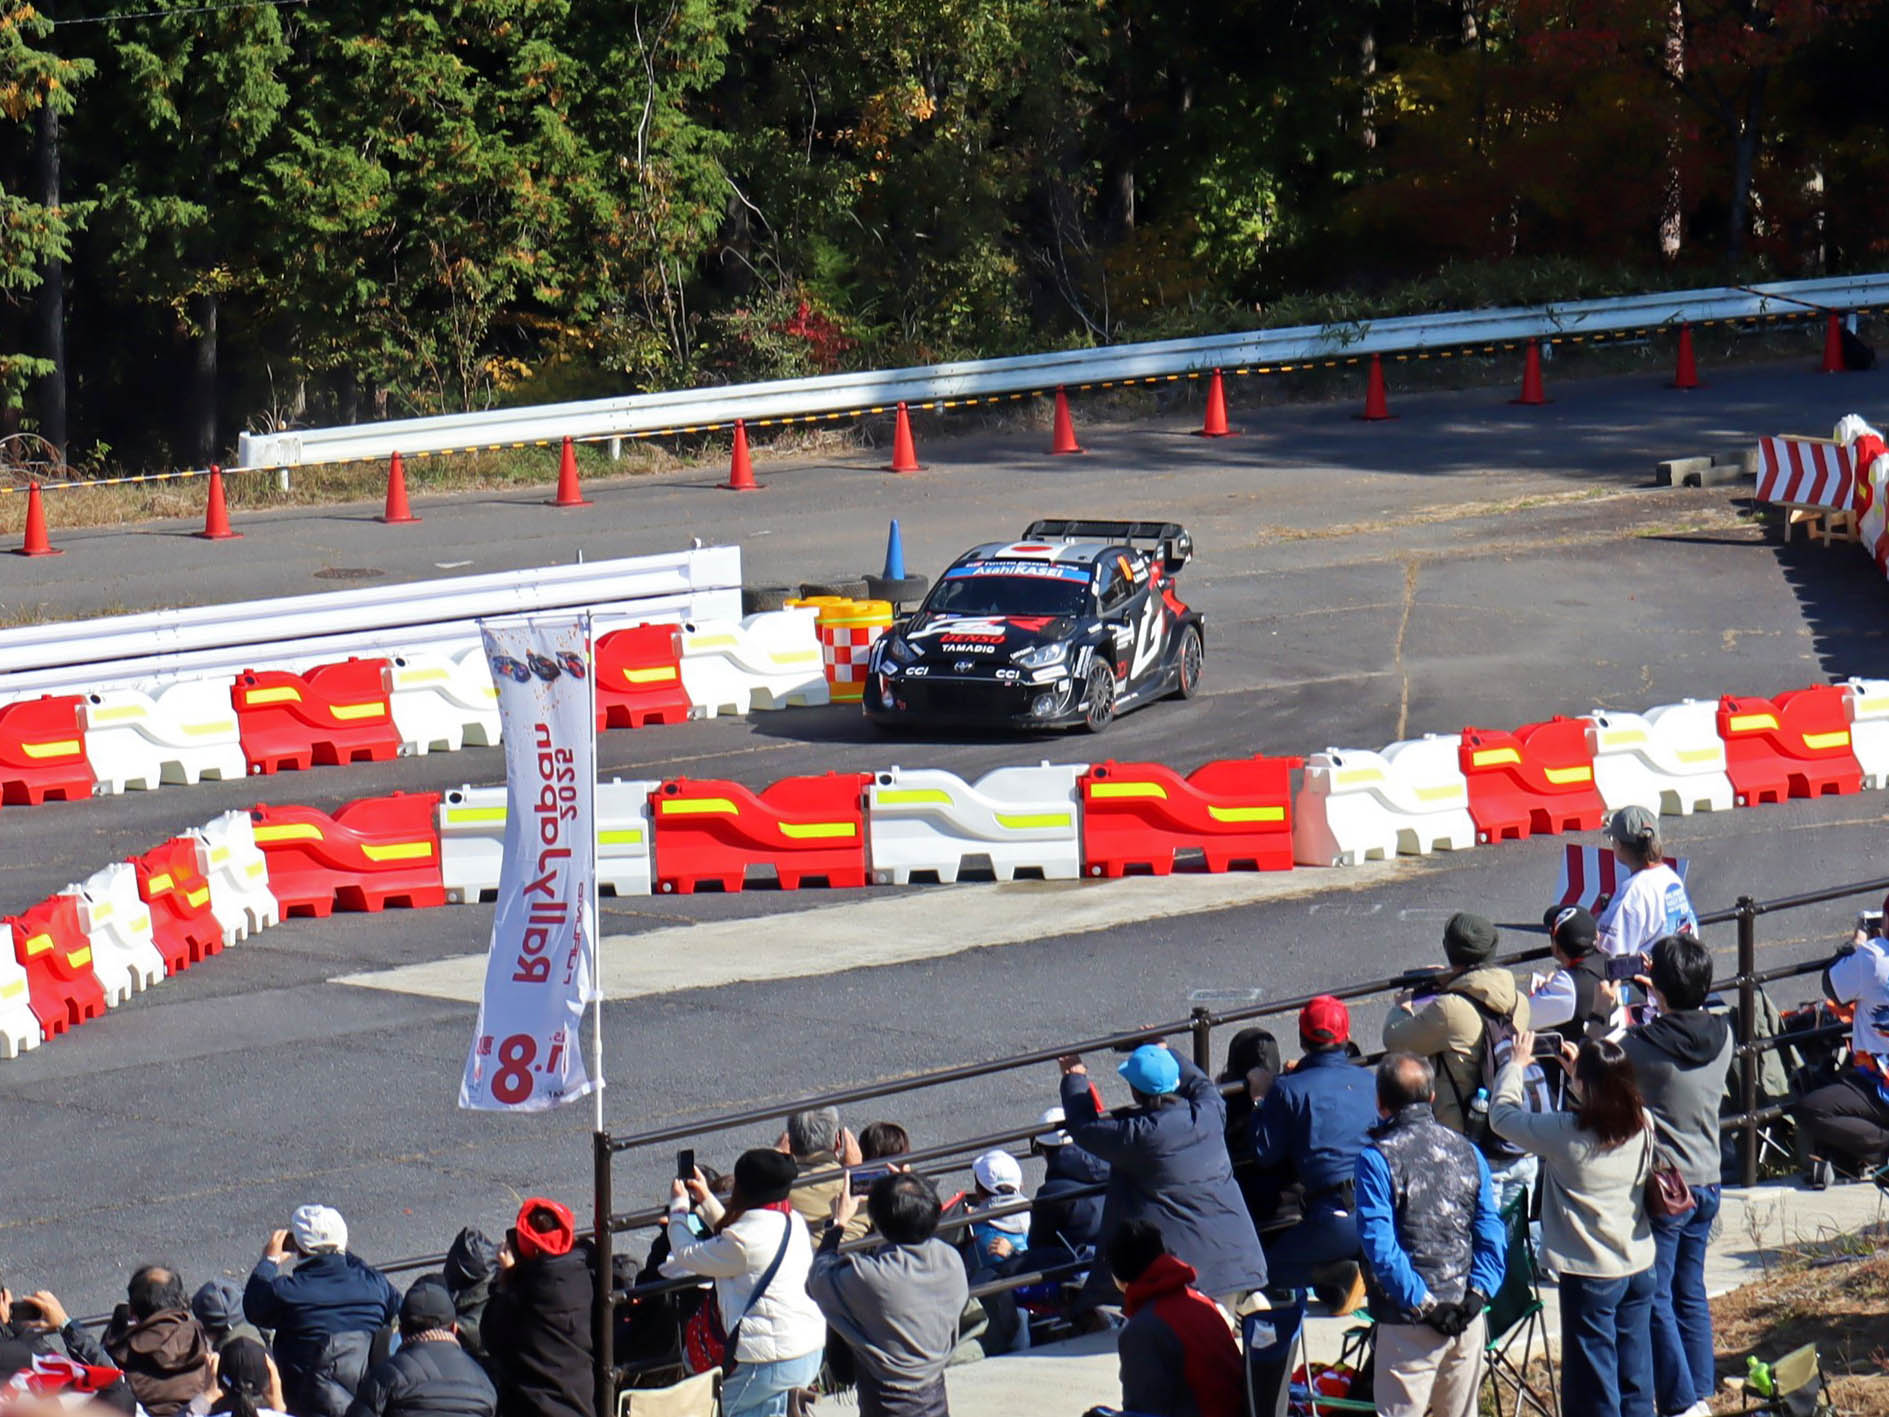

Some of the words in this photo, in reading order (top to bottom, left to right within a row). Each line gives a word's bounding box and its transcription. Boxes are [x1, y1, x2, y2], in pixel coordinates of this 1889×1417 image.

[940, 633, 1006, 644] DENSO
[905, 666, 930, 676] CCI
[995, 669, 1020, 680] CCI
